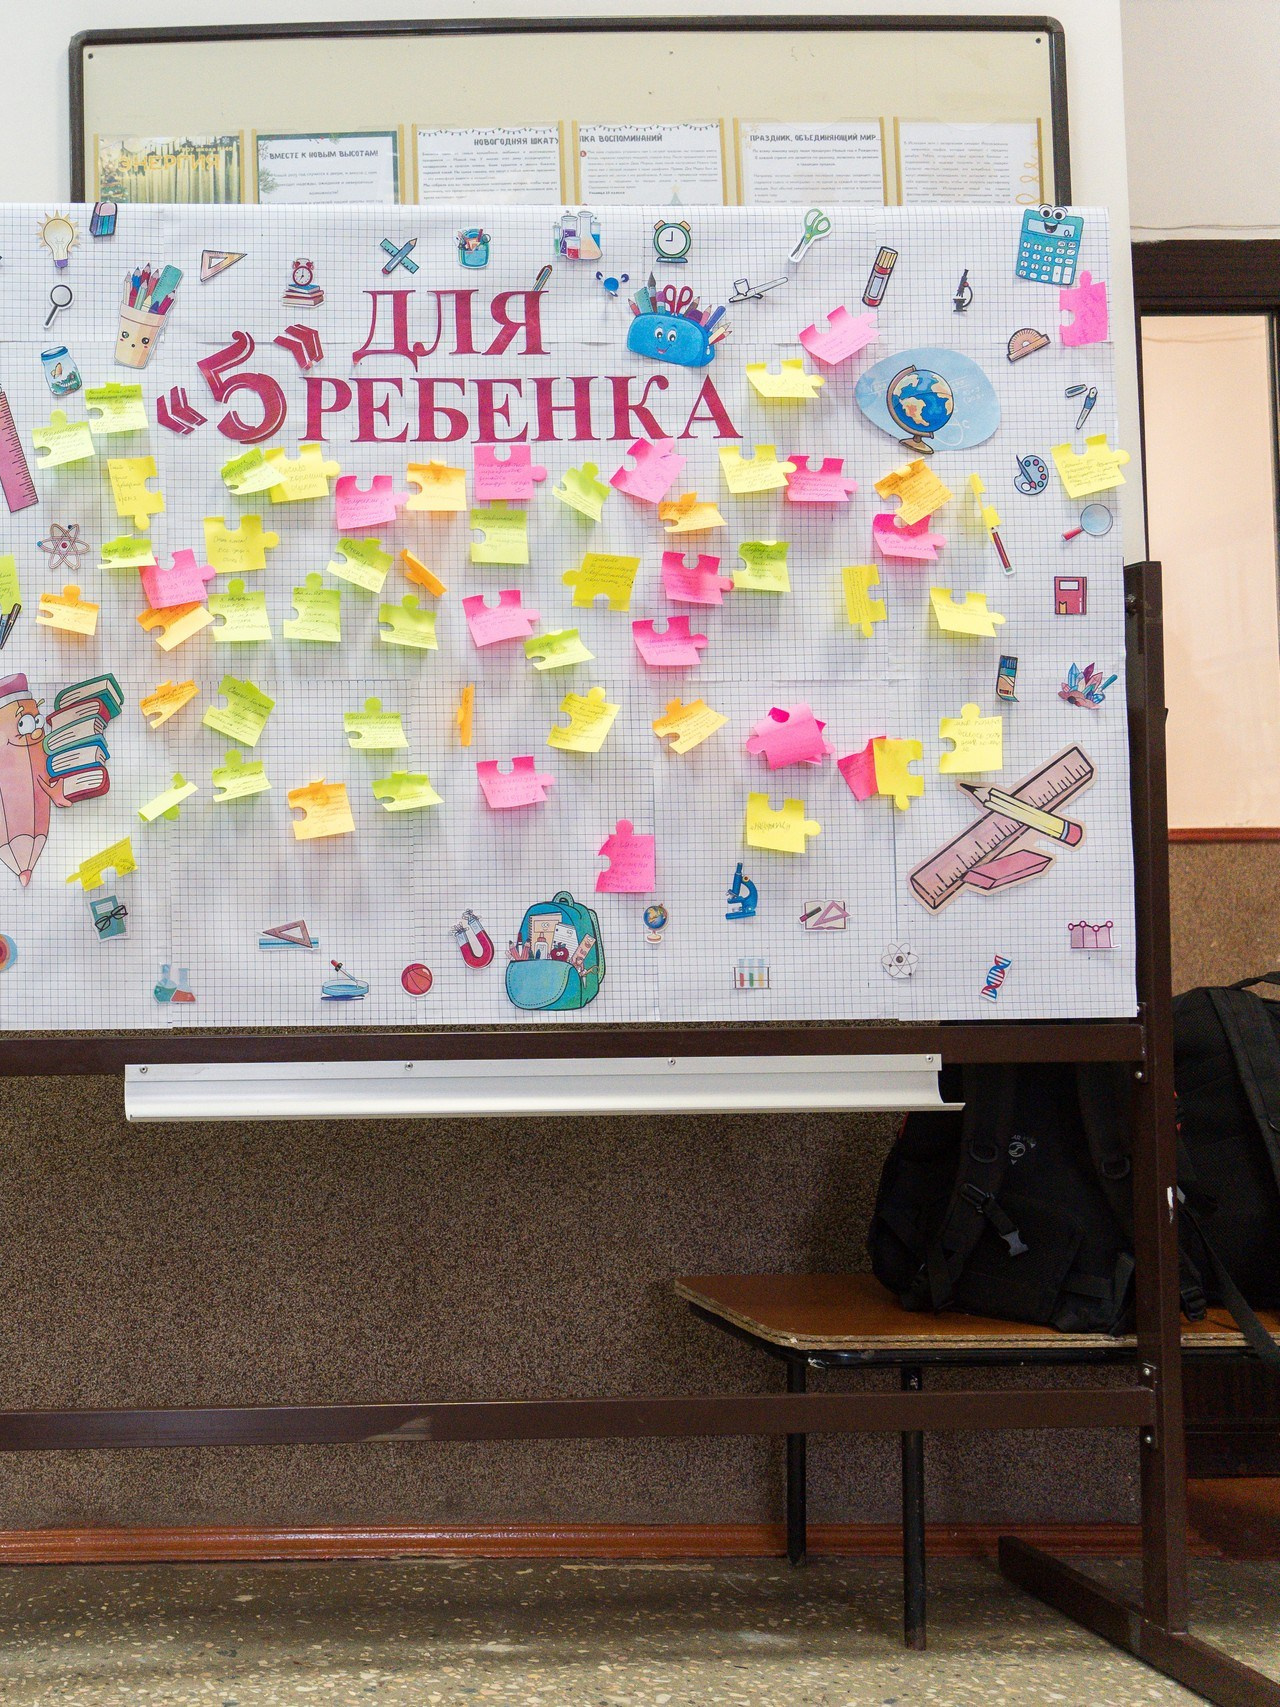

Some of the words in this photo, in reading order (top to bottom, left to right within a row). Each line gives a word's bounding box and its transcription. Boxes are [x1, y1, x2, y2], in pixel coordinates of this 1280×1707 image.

[474, 137, 527, 146] НОВОГОДНЯЯ
[599, 133, 663, 142] ВОСПОМИНАНИЙ
[750, 134, 793, 143] ПРАЗДНИК,
[794, 133, 858, 143] ОБЪЕДИНЯЮЩИЙ
[269, 152, 299, 160] ВМЕСТЕ
[309, 150, 337, 158] НОВЫМ
[339, 149, 379, 157] ВЫСОТАМ!
[118, 154, 221, 172] ЭНЕРГИЯ
[352, 289, 551, 372] ДЛЯ
[298, 373, 745, 444] РЕБЕНКА
